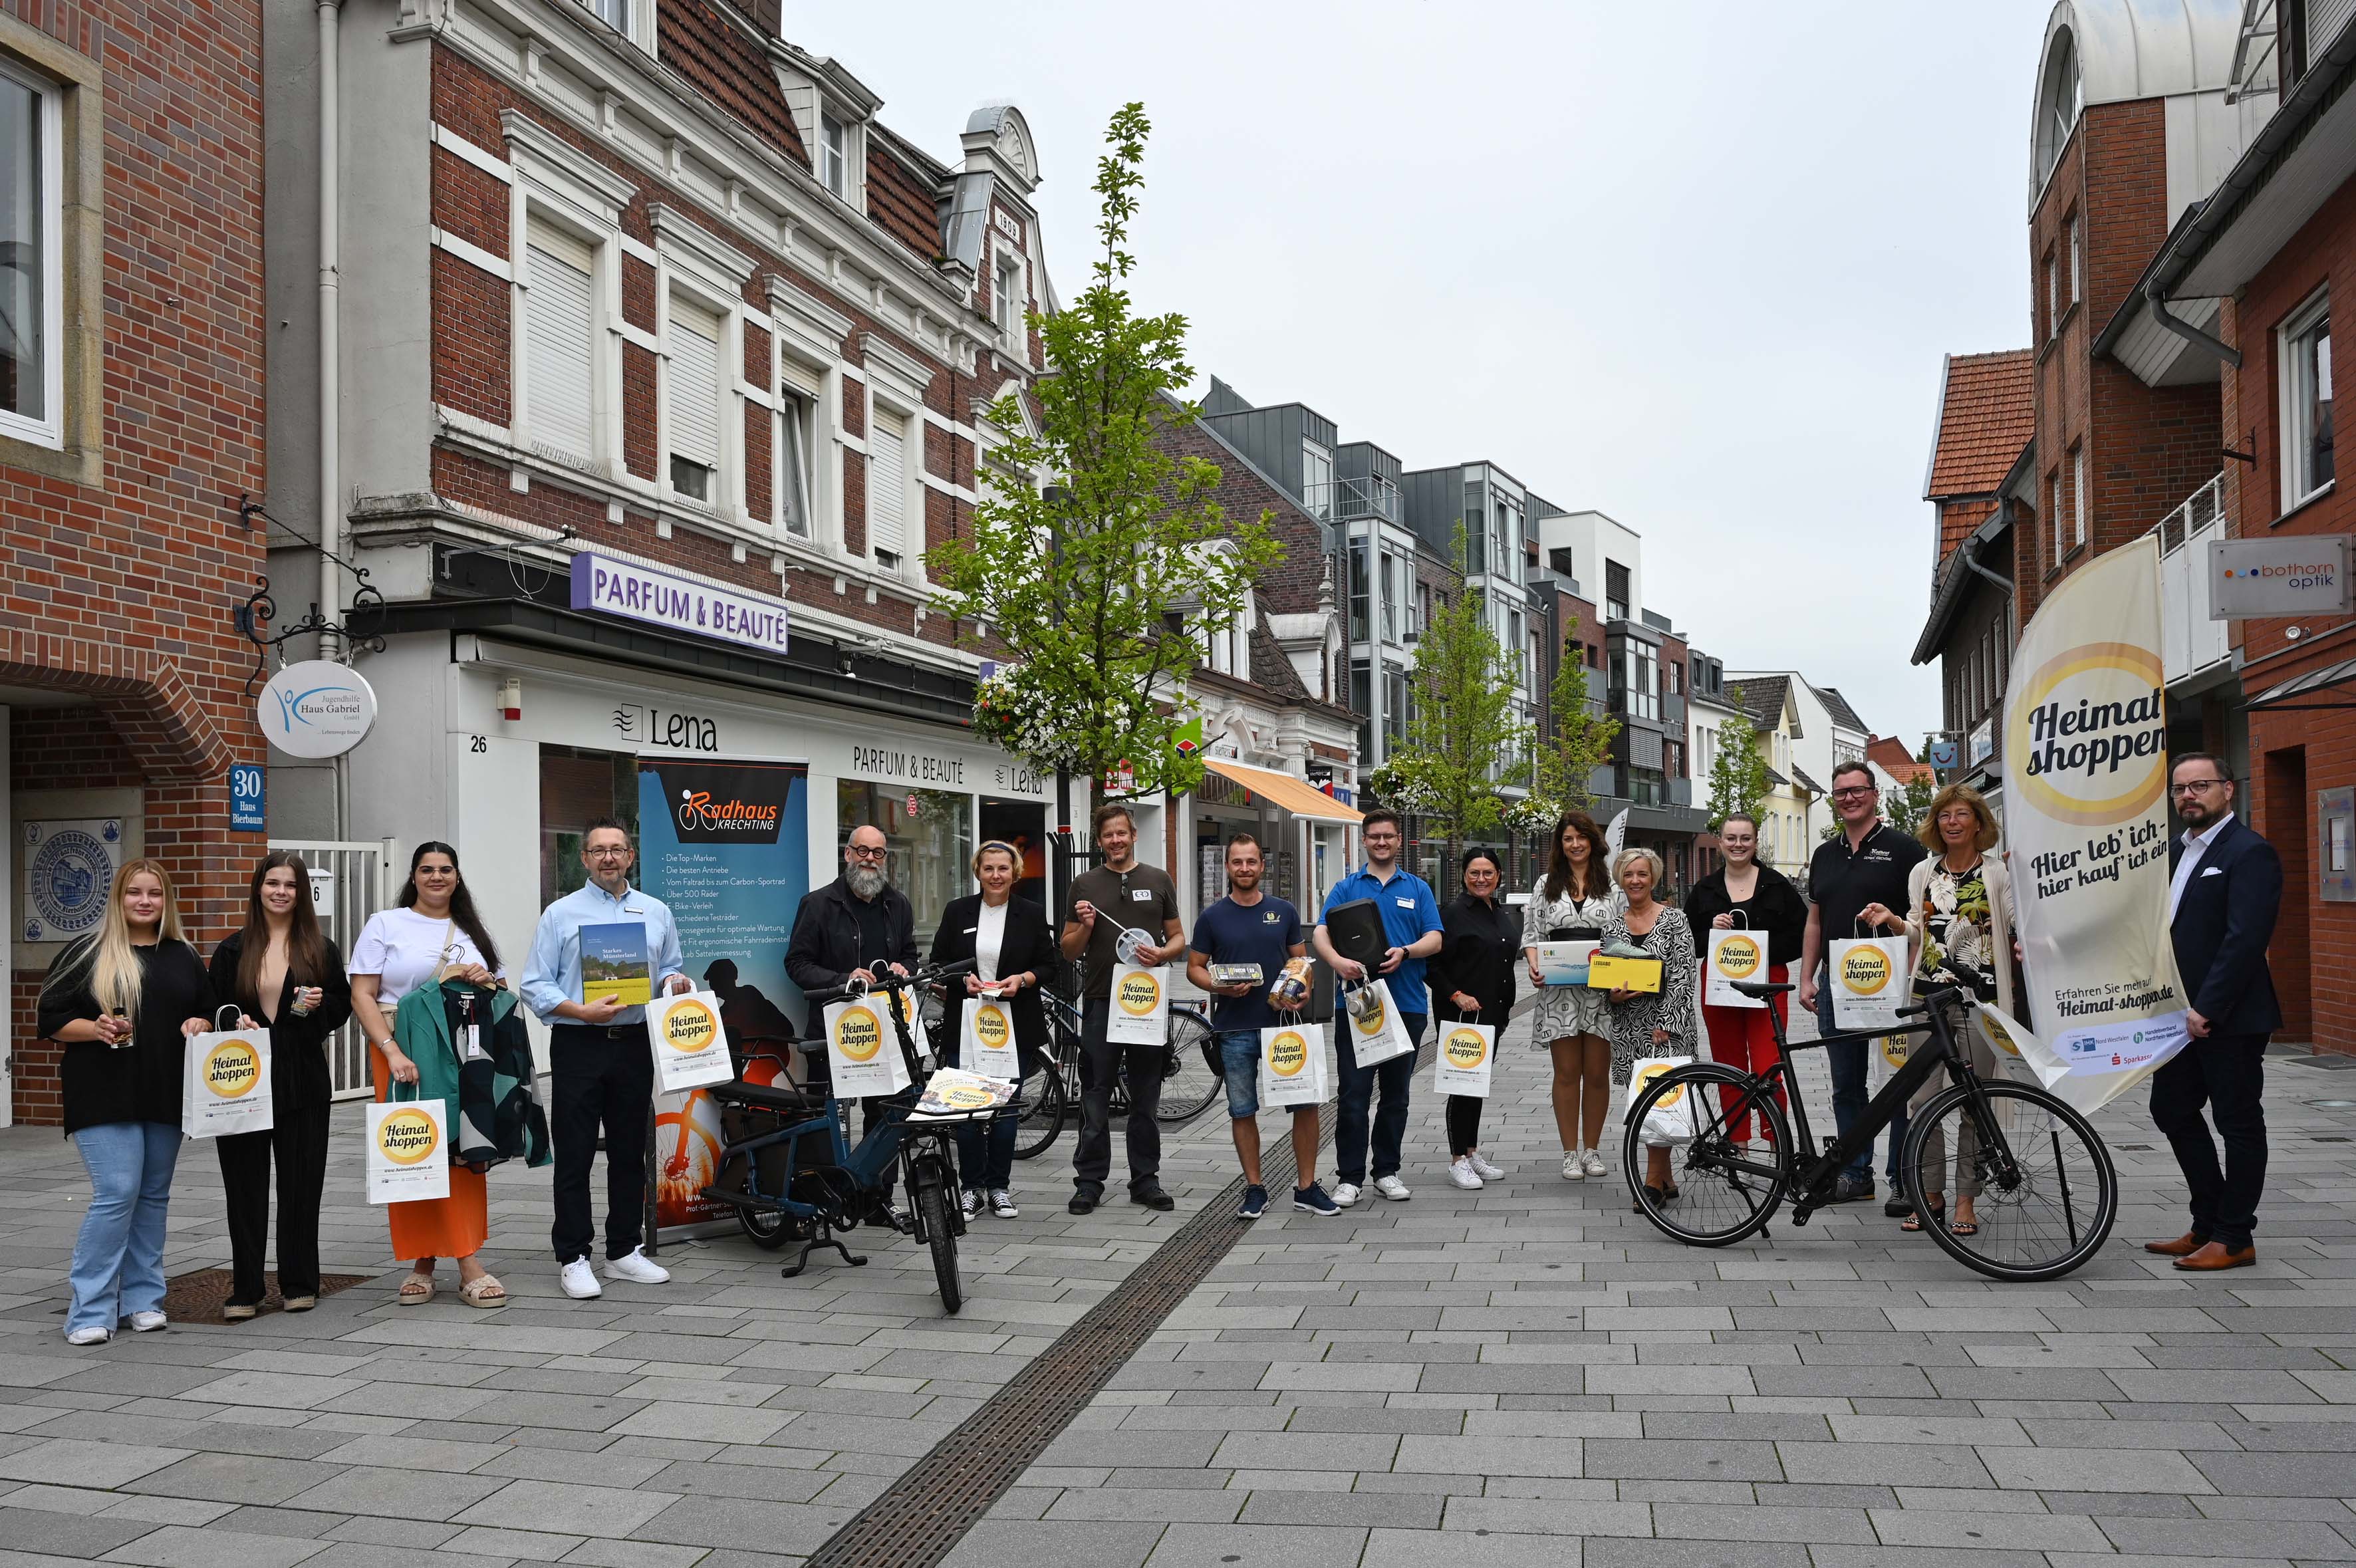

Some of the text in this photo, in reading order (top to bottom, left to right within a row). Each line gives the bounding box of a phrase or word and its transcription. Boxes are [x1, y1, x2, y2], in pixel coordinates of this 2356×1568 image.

[999, 213, 1017, 237] 1909
[2262, 564, 2335, 577] bothorn
[2289, 575, 2333, 589] optik
[595, 569, 784, 644] PARFUM & BEAUTÉ
[322, 695, 360, 704] Jugendhilfe
[327, 705, 360, 714] Gabriel
[2028, 687, 2162, 741] Heimat
[650, 710, 718, 751] Lena
[471, 735, 487, 753] 26
[2026, 727, 2166, 777] shoppen
[854, 746, 963, 784] PARFUM & BEAUTÉ
[234, 770, 261, 798] 30
[240, 801, 256, 811] Haus
[686, 791, 777, 819] Radhaus
[233, 813, 263, 824] Bierbaum
[718, 819, 774, 830] KRECHTING
[2031, 850, 2081, 878] Hier
[2129, 819, 2157, 848] ich
[679, 854, 717, 862] Top-Marken
[2037, 877, 2073, 899] hier
[2128, 849, 2148, 870] ich
[2151, 840, 2167, 860] ein
[730, 878, 785, 887] Carbon-Sportrad
[666, 889, 683, 898] Über
[678, 926, 716, 936] gnosegeräte
[727, 924, 756, 935] optimale
[757, 924, 785, 934] Wartung
[699, 938, 742, 948] ergonomische
[696, 950, 751, 958] Sattelvermessung
[1721, 947, 1754, 957] Heimat
[1719, 956, 1755, 967] shoppen
[1845, 959, 1883, 969] Heimat
[1845, 970, 1885, 981] shoppen
[1123, 983, 1154, 993] Heimat
[2055, 987, 2101, 1000] Erfahren
[2105, 983, 2120, 994] Sie
[1120, 992, 1155, 1004] shoppen
[2057, 984, 2174, 1017] Heimat-shoppen.de
[669, 1013, 708, 1028] Heimat
[979, 1017, 1003, 1027] Heimat
[670, 1025, 712, 1038] shoppen
[841, 1022, 874, 1035] Heimat
[979, 1026, 1005, 1037] shoppen
[841, 1034, 877, 1047] shoppen
[1450, 1038, 1481, 1049] Heimat
[1273, 1043, 1301, 1054] Heimat
[1448, 1047, 1482, 1058] shoppen
[212, 1055, 251, 1070] Heimat
[1271, 1053, 1303, 1064] shoppen
[2124, 1053, 2153, 1064] Sparkasse
[209, 1067, 255, 1082] shoppen
[947, 1095, 985, 1103] shoppen
[386, 1124, 429, 1136] Heimat
[384, 1136, 432, 1149] shoppen
